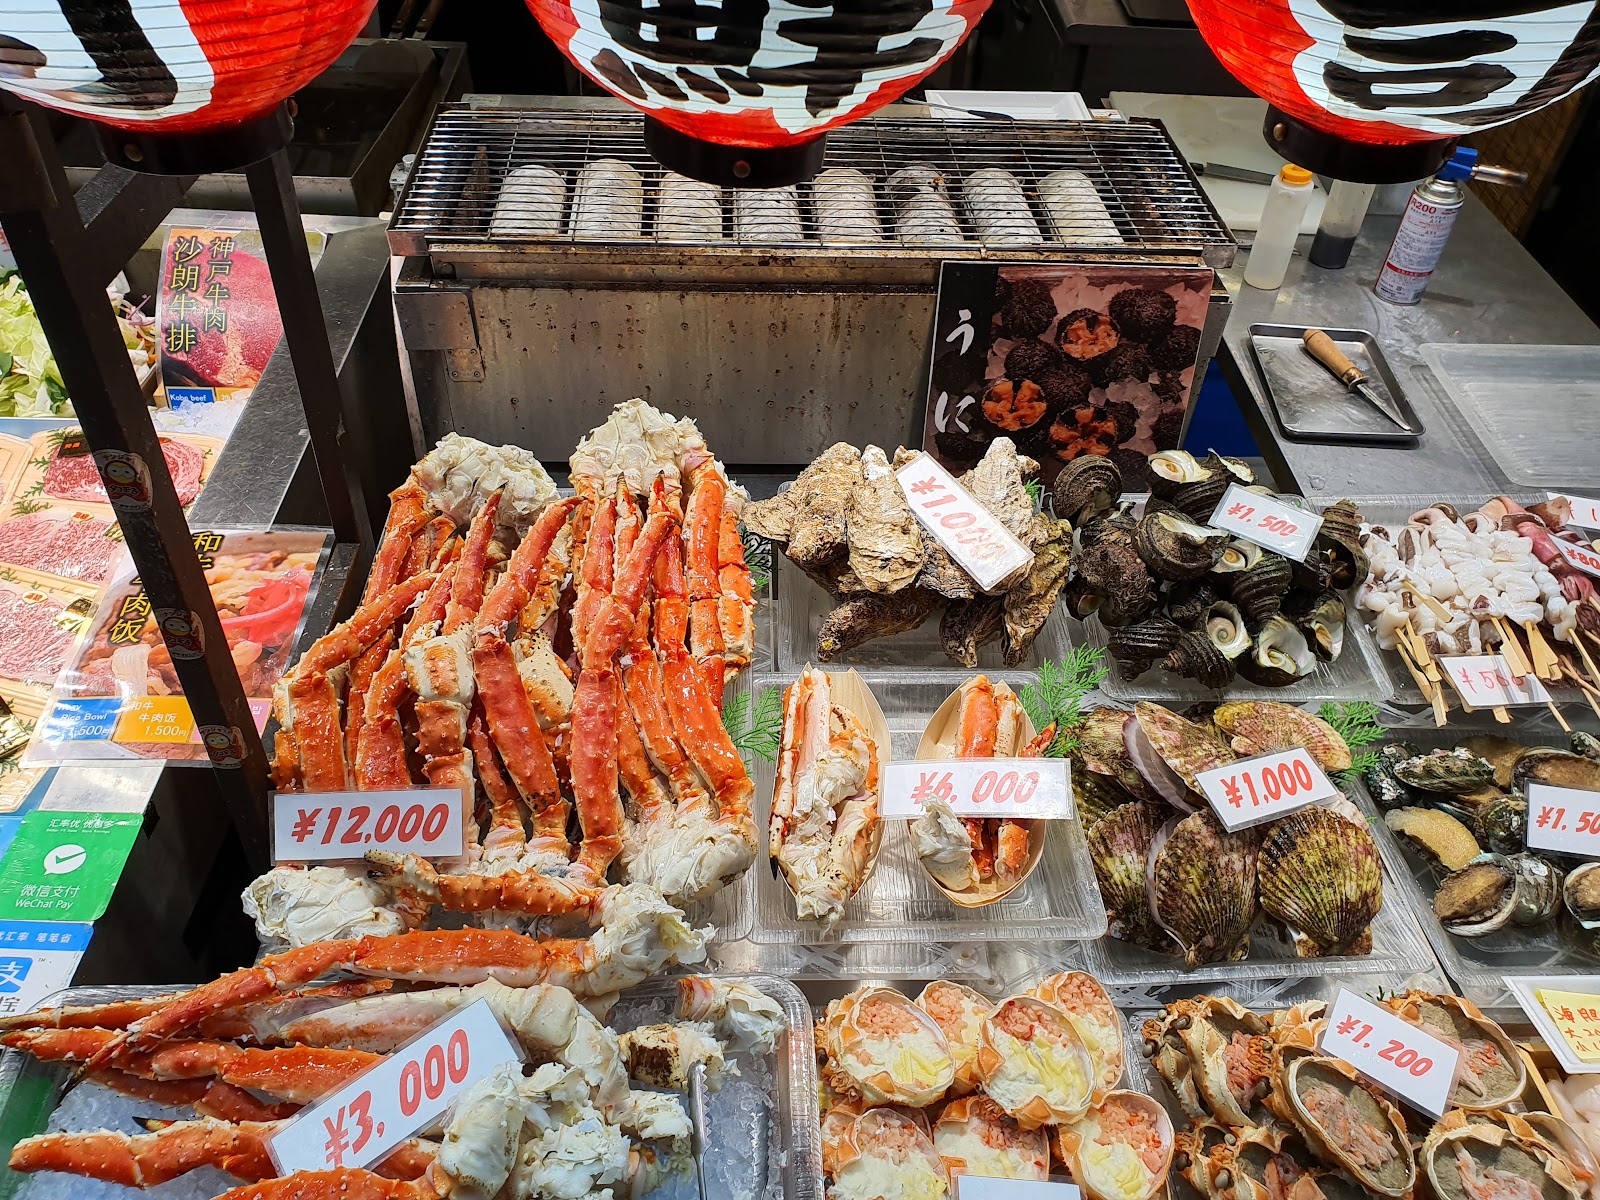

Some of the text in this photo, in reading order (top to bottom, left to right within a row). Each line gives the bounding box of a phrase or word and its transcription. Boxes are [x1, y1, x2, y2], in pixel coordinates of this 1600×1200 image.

[205, 237, 235, 332] 神戸牛肉
[167, 236, 203, 352] 沙朗牛排
[934, 309, 976, 433] うに
[190, 393, 207, 401] beef
[110, 576, 151, 644] 肉饭
[84, 712, 108, 721] Bowl
[138, 712, 177, 723] 牛肉饭
[144, 725, 187, 737] 1,500円
[1219, 759, 1313, 809] ¥1,000
[291, 803, 450, 845] ¥12,000
[20, 884, 81, 898] 微信支付
[15, 899, 74, 911] WeChat Pay
[0, 996, 21, 1012] 宝
